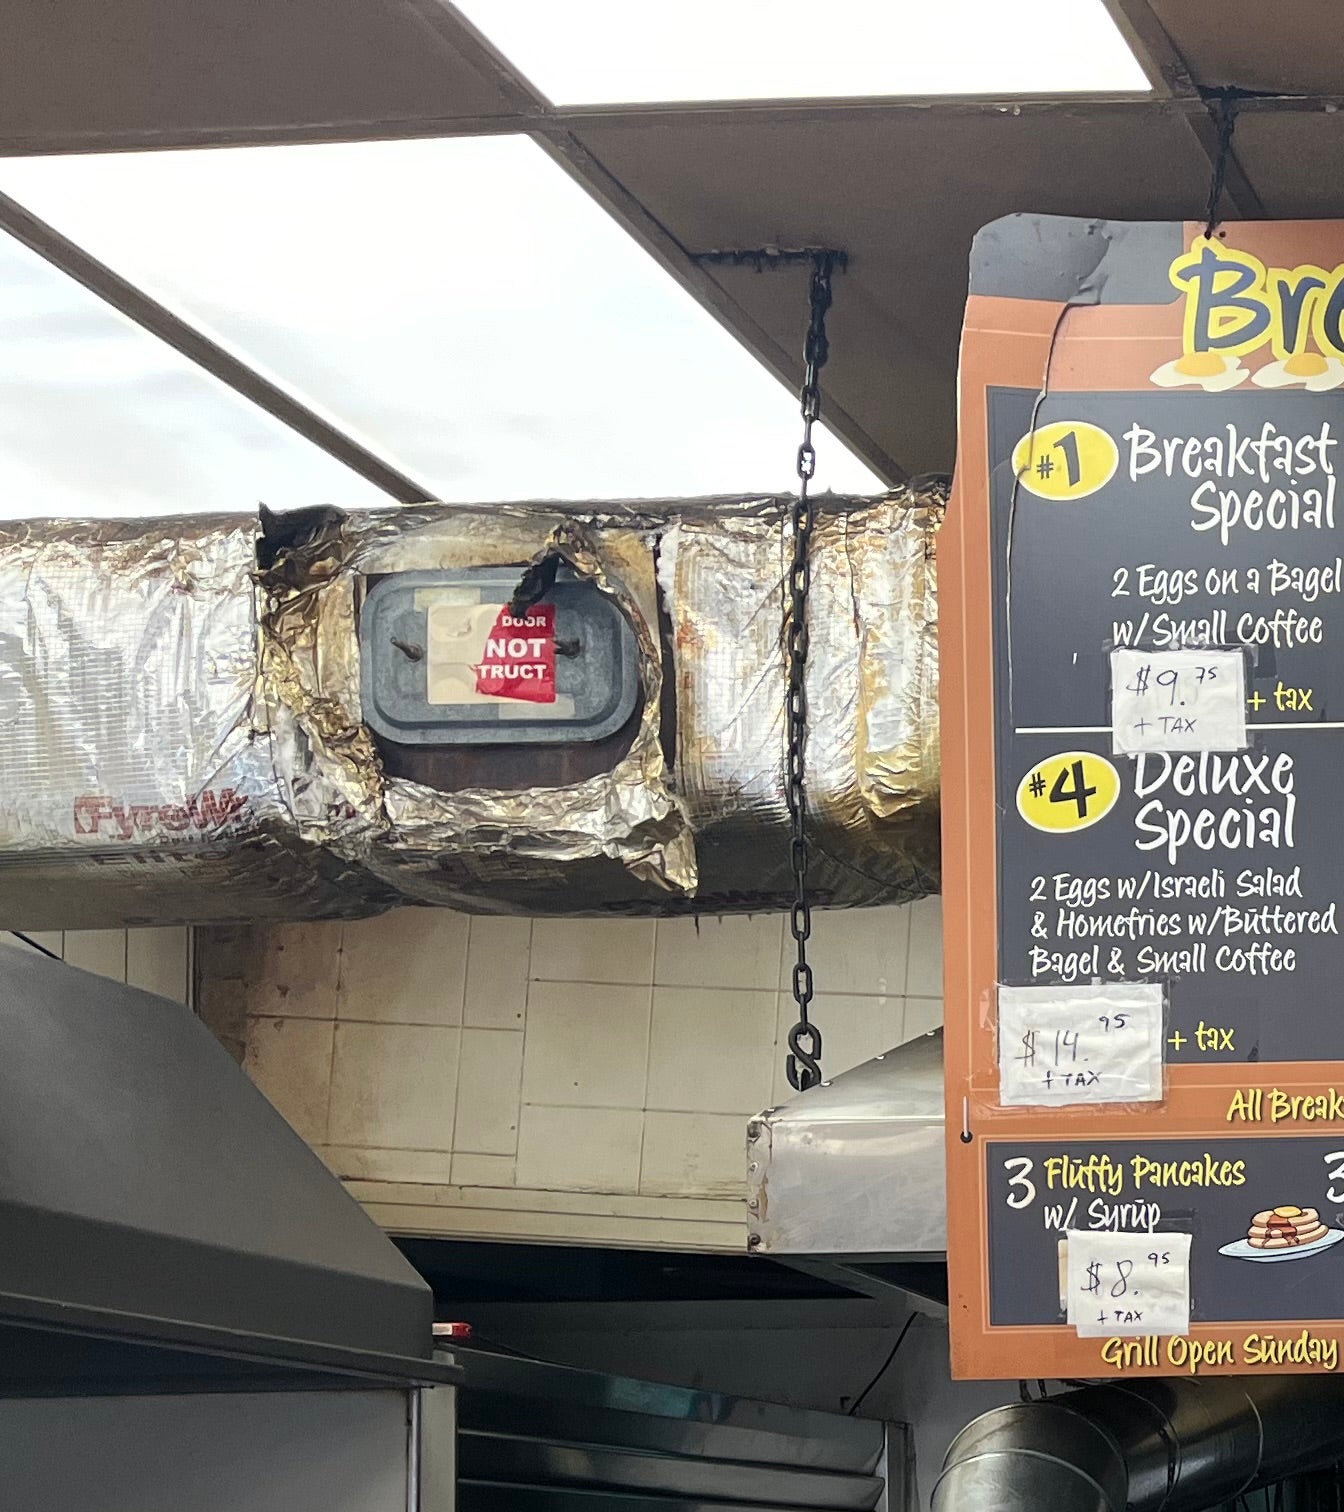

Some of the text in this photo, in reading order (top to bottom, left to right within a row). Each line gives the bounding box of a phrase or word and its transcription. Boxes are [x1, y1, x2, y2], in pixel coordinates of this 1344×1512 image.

[1036, 421, 1338, 486] #1 Breakfast
[1190, 476, 1336, 545] Special
[1113, 558, 1341, 604] 2 Eggs on a Bagel
[486, 637, 547, 658] NOT
[1029, 752, 1293, 818] #4 Deluxe
[1135, 794, 1295, 864] Special
[1227, 1090, 1262, 1122] All
[1003, 1156, 1036, 1210] 3
[1131, 1156, 1246, 1191] Pancakes
[1043, 1204, 1074, 1232] w/
[1101, 1336, 1161, 1368] Grill
[1166, 1336, 1234, 1374] Open
